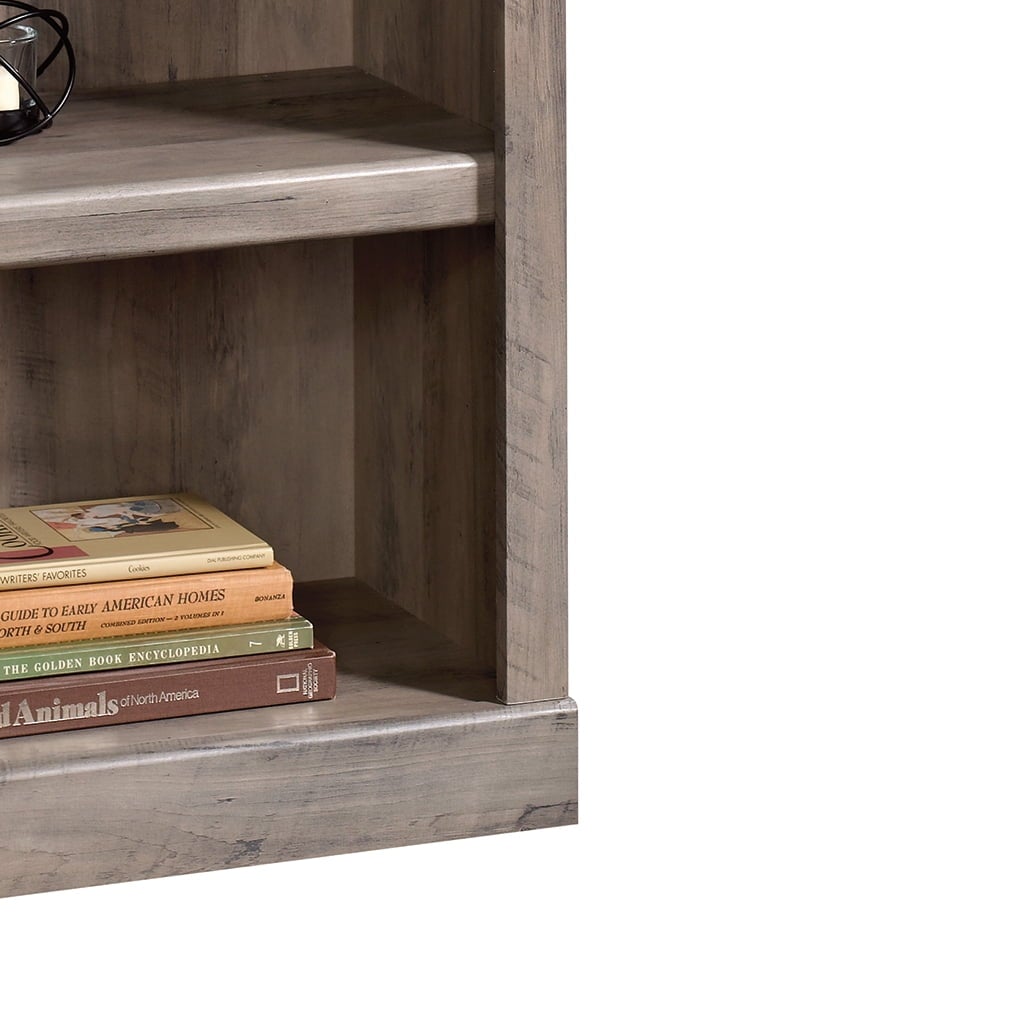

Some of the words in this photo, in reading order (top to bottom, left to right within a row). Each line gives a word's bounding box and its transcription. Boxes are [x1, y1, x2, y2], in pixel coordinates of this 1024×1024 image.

[242, 553, 266, 561] COMPANY
[0, 573, 40, 585] WRITERS'
[42, 568, 87, 581] FAVORITES
[128, 564, 151, 574] Cookies
[0, 608, 39, 622] GUIDE
[41, 607, 59, 619] TO
[61, 603, 98, 617] EARLY
[101, 594, 174, 613] AMERICAN
[177, 588, 226, 605] HOMES
[254, 593, 286, 603] BONANZA
[34, 625, 43, 635] &
[45, 620, 87, 634] SOUTH
[100, 619, 136, 629] COMBINED
[137, 616, 166, 625] EDITION
[180, 611, 211, 621] VOLUMES
[249, 640, 263, 648] 7
[3, 663, 29, 676] THE
[34, 658, 82, 672] GOLDEN
[89, 653, 123, 667] BOOK
[129, 644, 220, 663] ENCYCLOPEDIA
[12, 690, 119, 726] Animals
[120, 695, 131, 707] of
[130, 693, 158, 706] North
[158, 688, 199, 702] America
